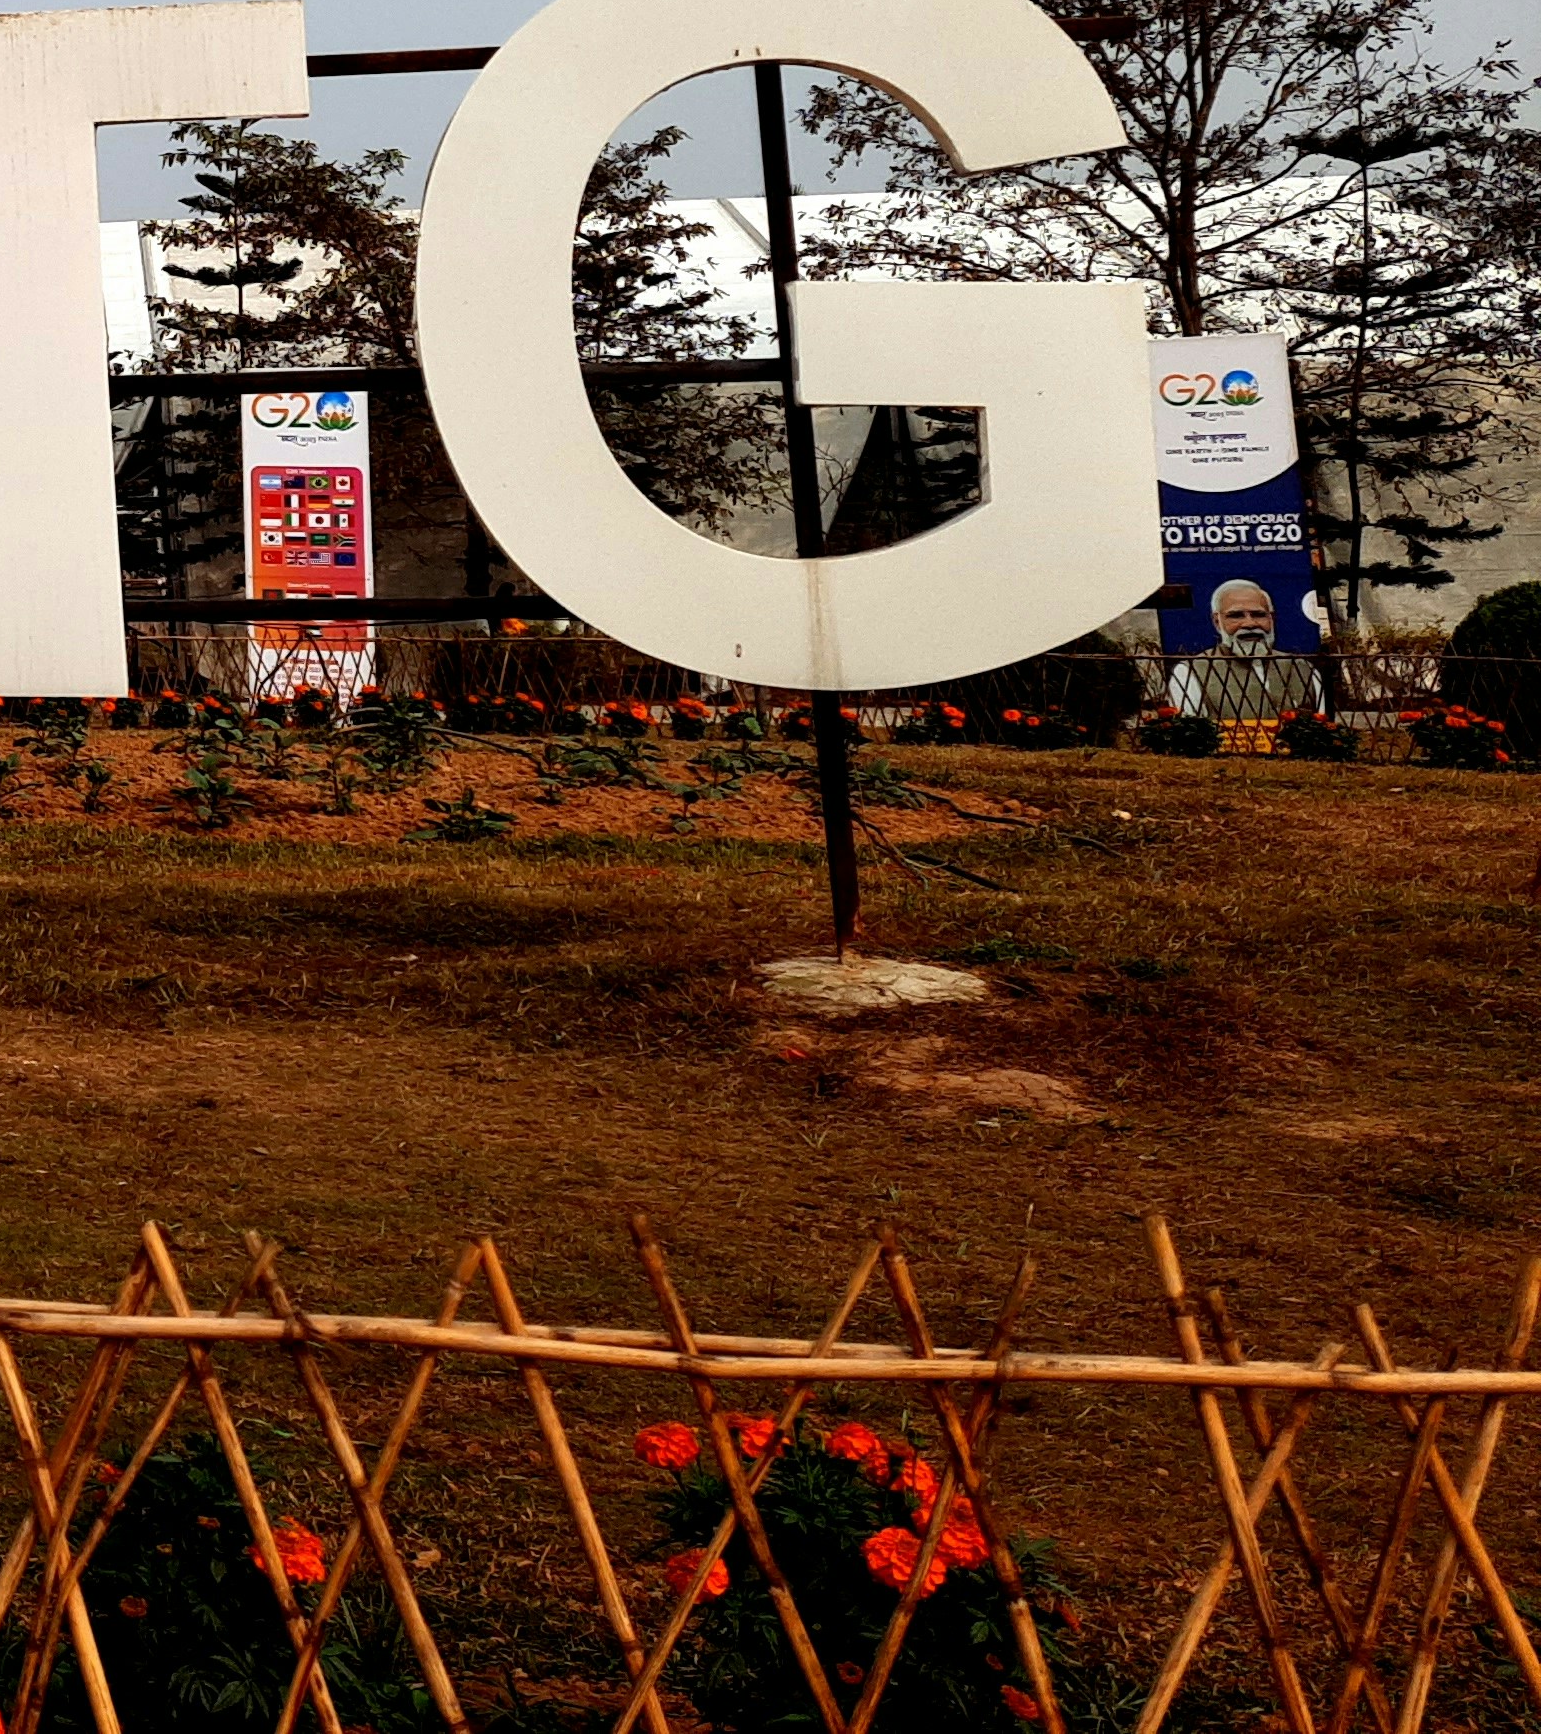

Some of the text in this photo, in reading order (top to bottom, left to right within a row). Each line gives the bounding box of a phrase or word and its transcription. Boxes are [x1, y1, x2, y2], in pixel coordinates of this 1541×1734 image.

[1161, 513, 1301, 526] OTHER OF DEMOCRACY
[1188, 525, 1250, 544] HOST
[1256, 524, 1302, 543] G20
